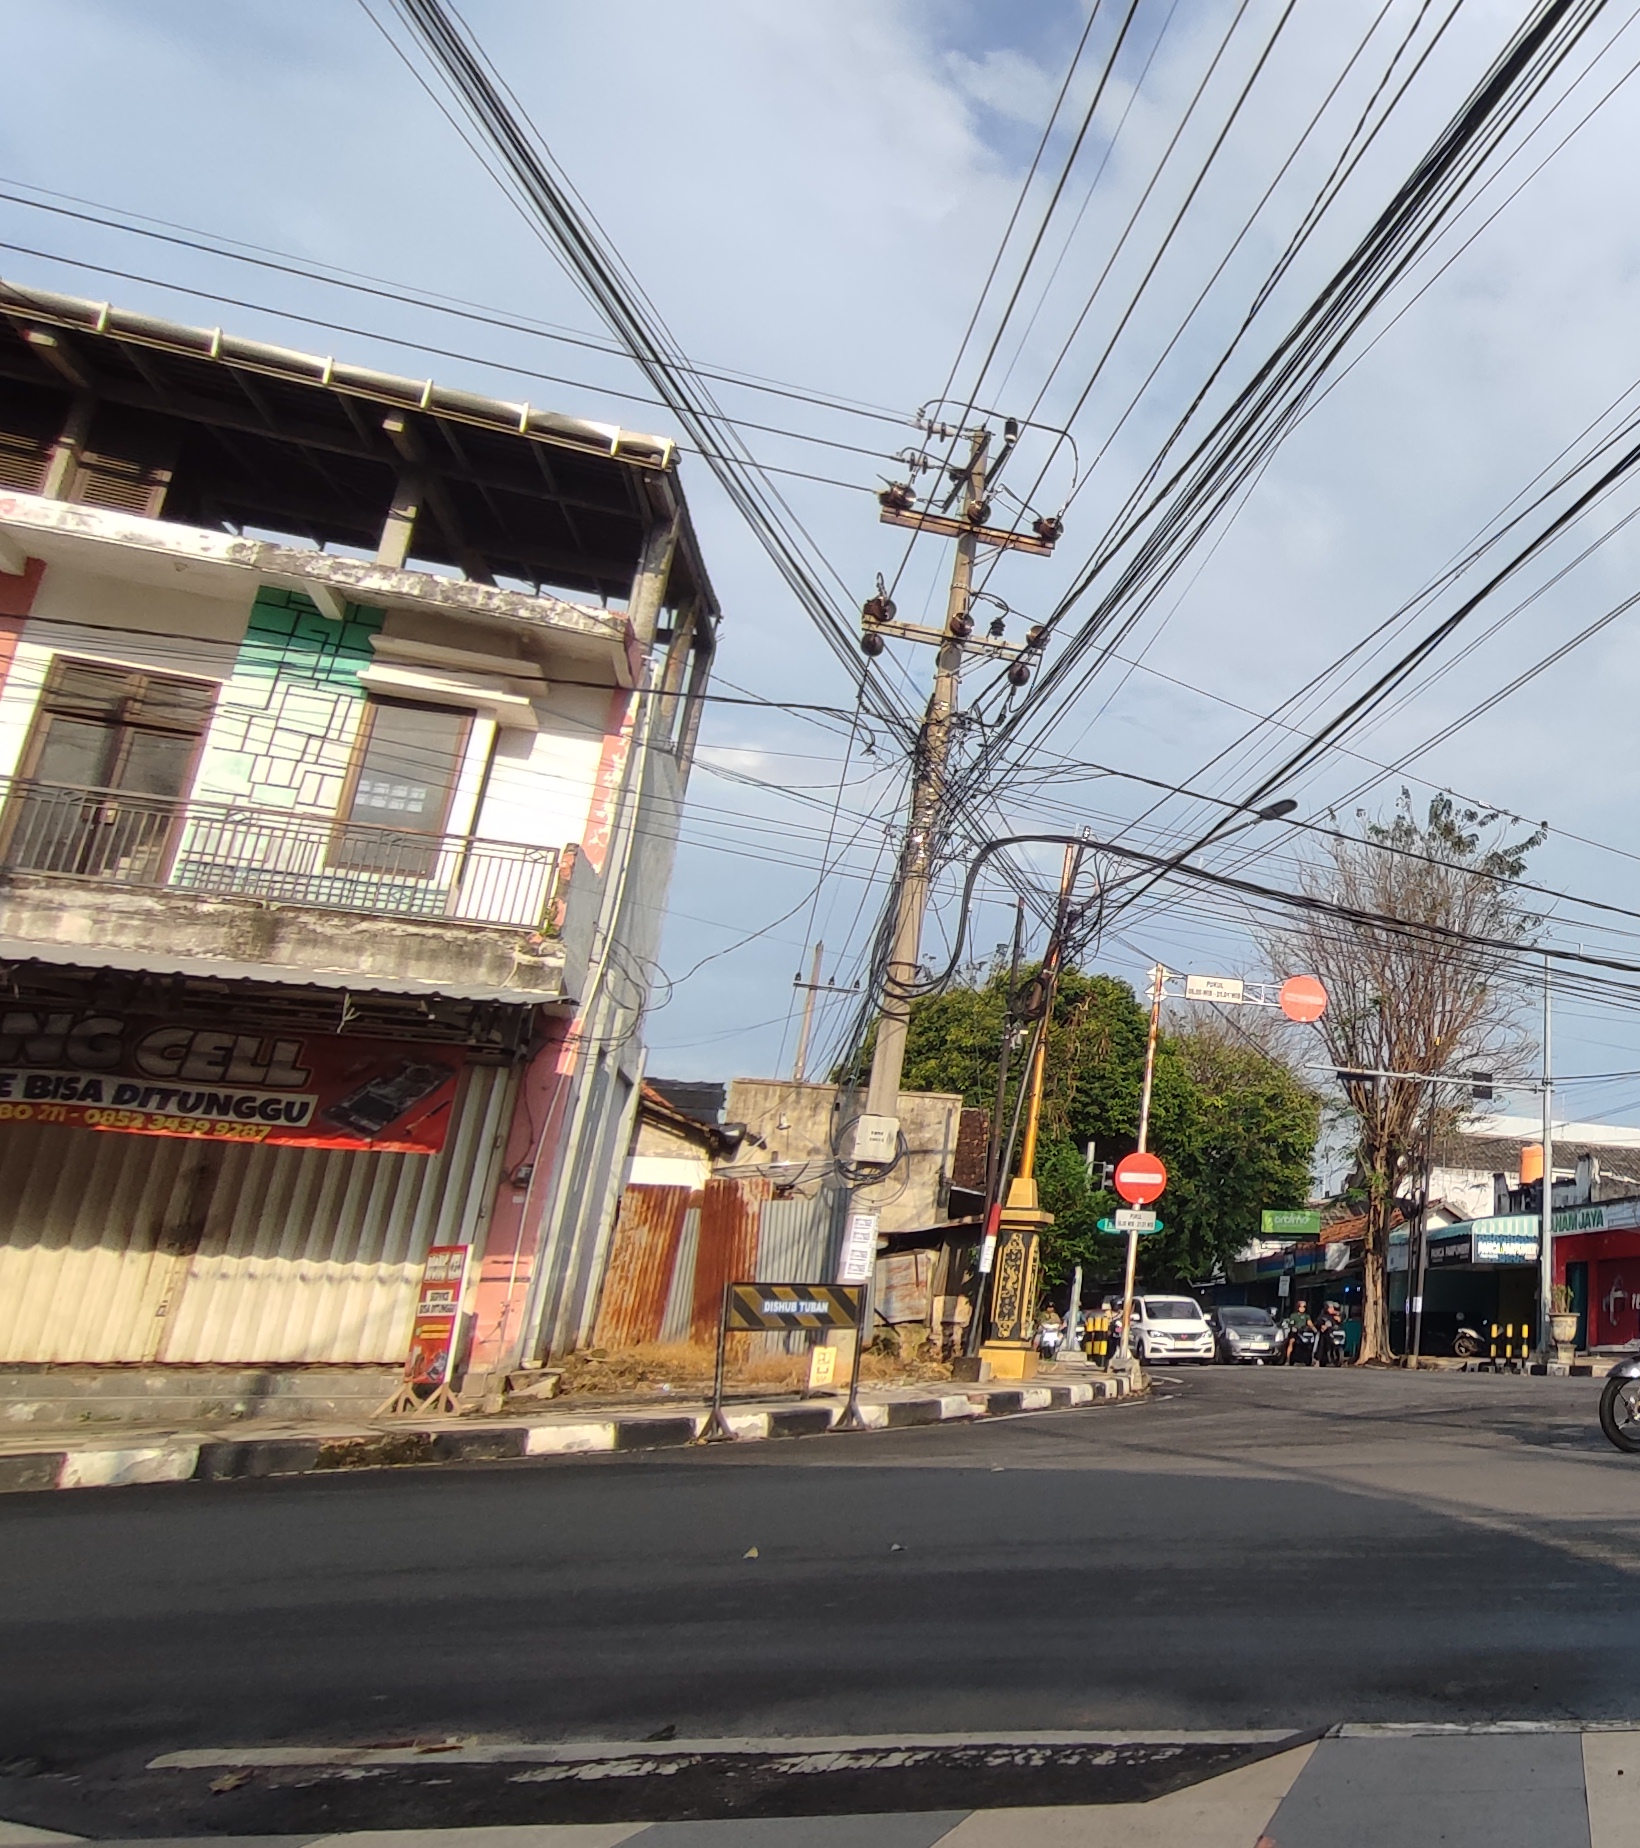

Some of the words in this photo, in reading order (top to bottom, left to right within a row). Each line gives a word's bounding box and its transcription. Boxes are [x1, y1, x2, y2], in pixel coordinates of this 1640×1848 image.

[137, 1028, 311, 1087] CELL
[23, 1075, 104, 1103] BISA
[112, 1083, 310, 1123] DITUNGGU
[85, 1108, 145, 1128] 0852
[148, 1113, 208, 1134] 3439
[213, 1122, 272, 1140] 9287
[1579, 1208, 1604, 1229] JAYA
[764, 1301, 797, 1313] DISHUB
[799, 1301, 829, 1313] TUBAN
